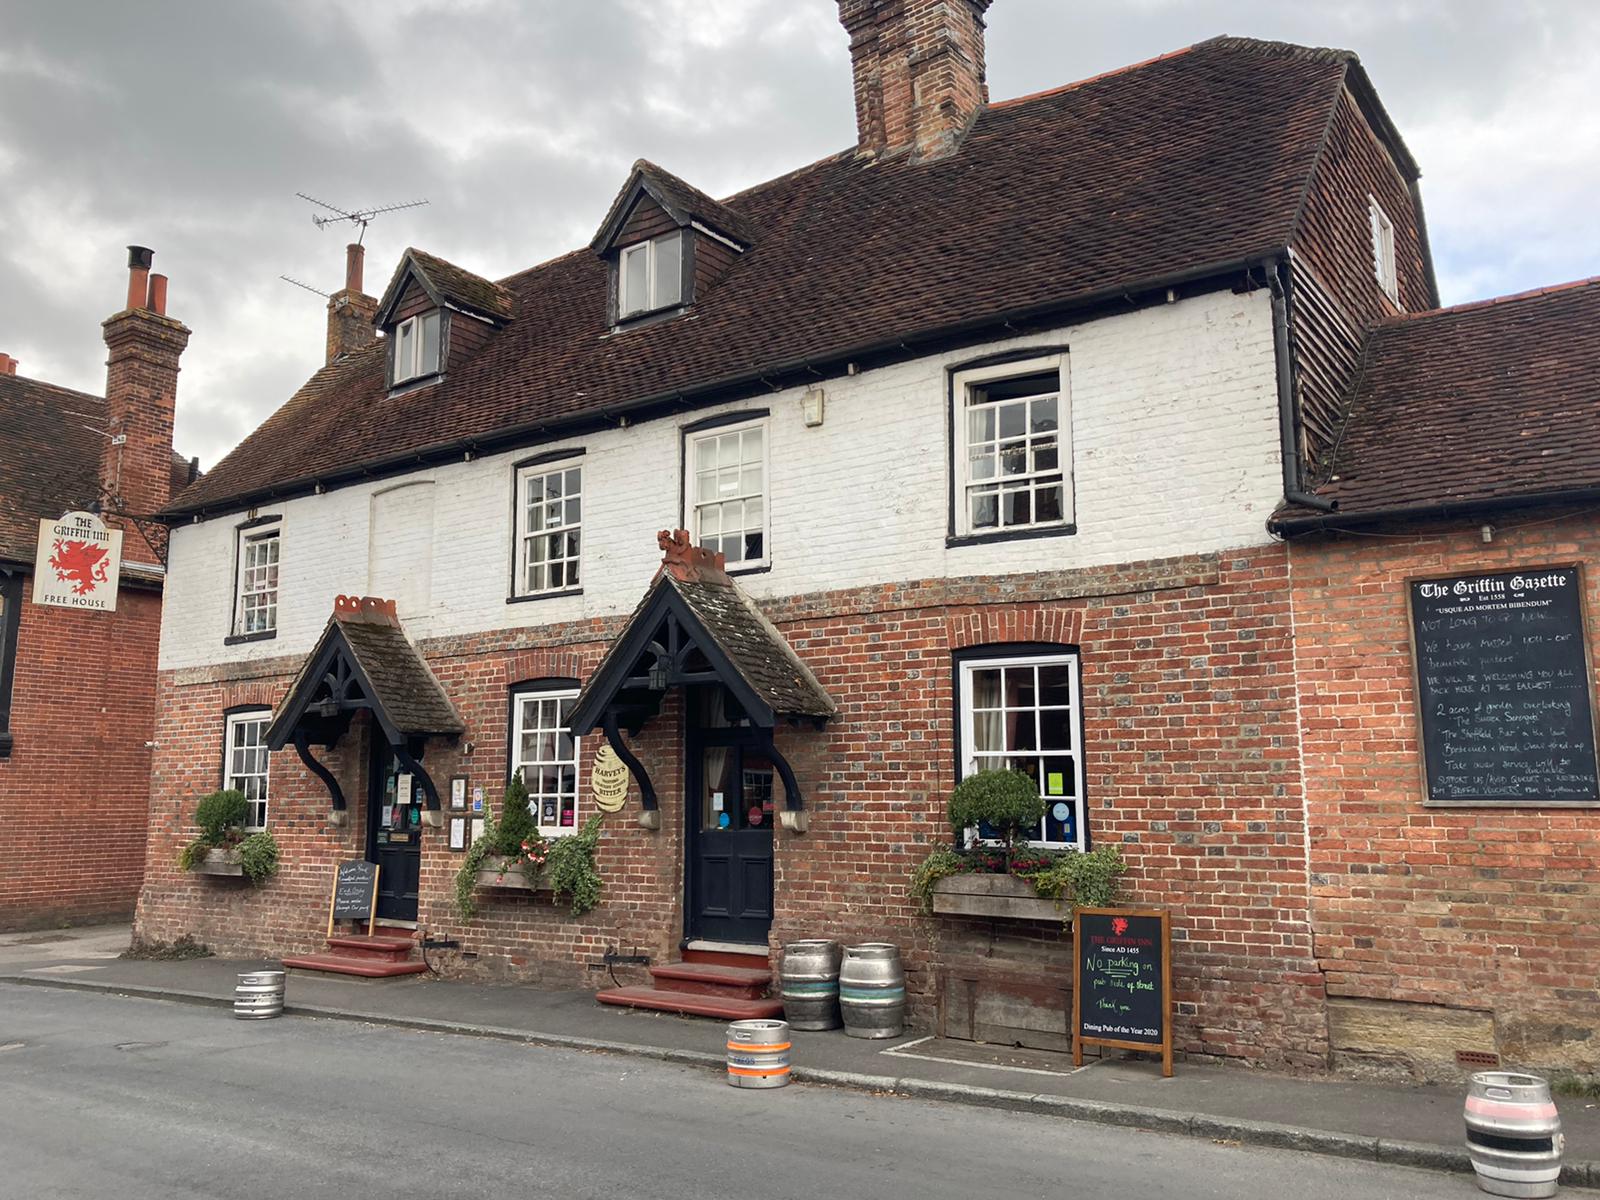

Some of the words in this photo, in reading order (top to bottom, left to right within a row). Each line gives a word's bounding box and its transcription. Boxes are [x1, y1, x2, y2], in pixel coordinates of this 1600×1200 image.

[74, 517, 92, 528] THE
[1420, 583, 1449, 599] The
[1453, 578, 1505, 595] Griffin
[1510, 574, 1566, 591] Gazette
[44, 594, 68, 604] FREE
[72, 598, 105, 608] HOUSE
[1436, 704, 1446, 716] 2
[1086, 953, 1102, 972] No
[1108, 956, 1138, 976] parking
[1142, 963, 1152, 971] on
[1094, 978, 1106, 990] pub
[1084, 1022, 1102, 1032] Dining
[1102, 1024, 1114, 1032] Pub
[1120, 1026, 1130, 1034] the
[1144, 1028, 1158, 1036] 2020
